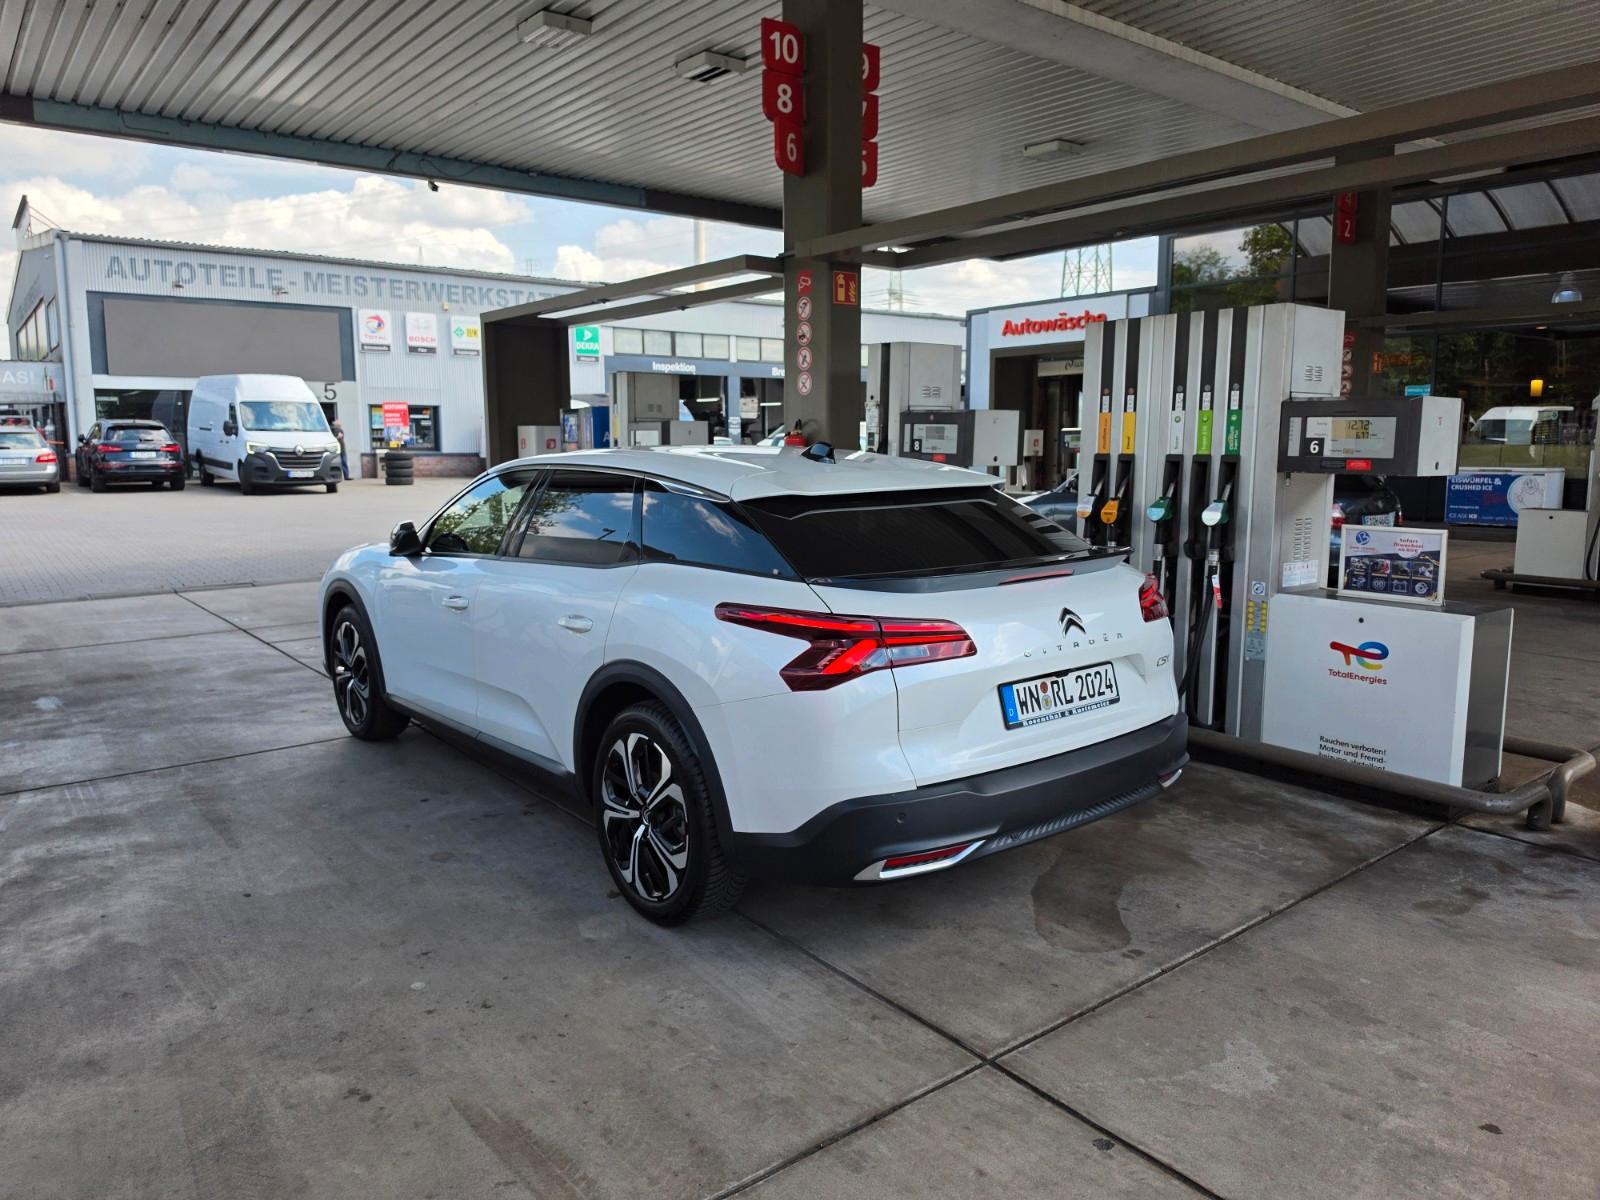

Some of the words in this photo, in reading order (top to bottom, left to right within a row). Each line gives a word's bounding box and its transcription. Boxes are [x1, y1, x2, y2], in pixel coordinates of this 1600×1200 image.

[769, 32, 799, 64] 10
[777, 83, 793, 114] 8
[786, 132, 798, 162] 6
[1344, 219, 1351, 238] 2
[105, 255, 284, 291] AUTOTEILE
[1001, 310, 1108, 336] Autowäsche
[408, 335, 436, 343] BOSCH
[576, 341, 600, 350] DEKRA
[652, 361, 697, 375] Inspektion
[323, 382, 337, 401] 5
[913, 440, 921, 451] 8
[1309, 440, 1320, 454] 6
[1494, 477, 1502, 485] &
[1328, 668, 1388, 685] TotalEnergies
[1015, 686, 1042, 716] WN
[1050, 680, 1074, 708] RL
[1075, 668, 1114, 702] 2024
[1319, 735, 1350, 748] Rauchen
[1350, 743, 1387, 756] verboten!
[1319, 743, 1342, 754] Motor
[1343, 750, 1359, 759] und
[1360, 752, 1387, 764] Fremd-
